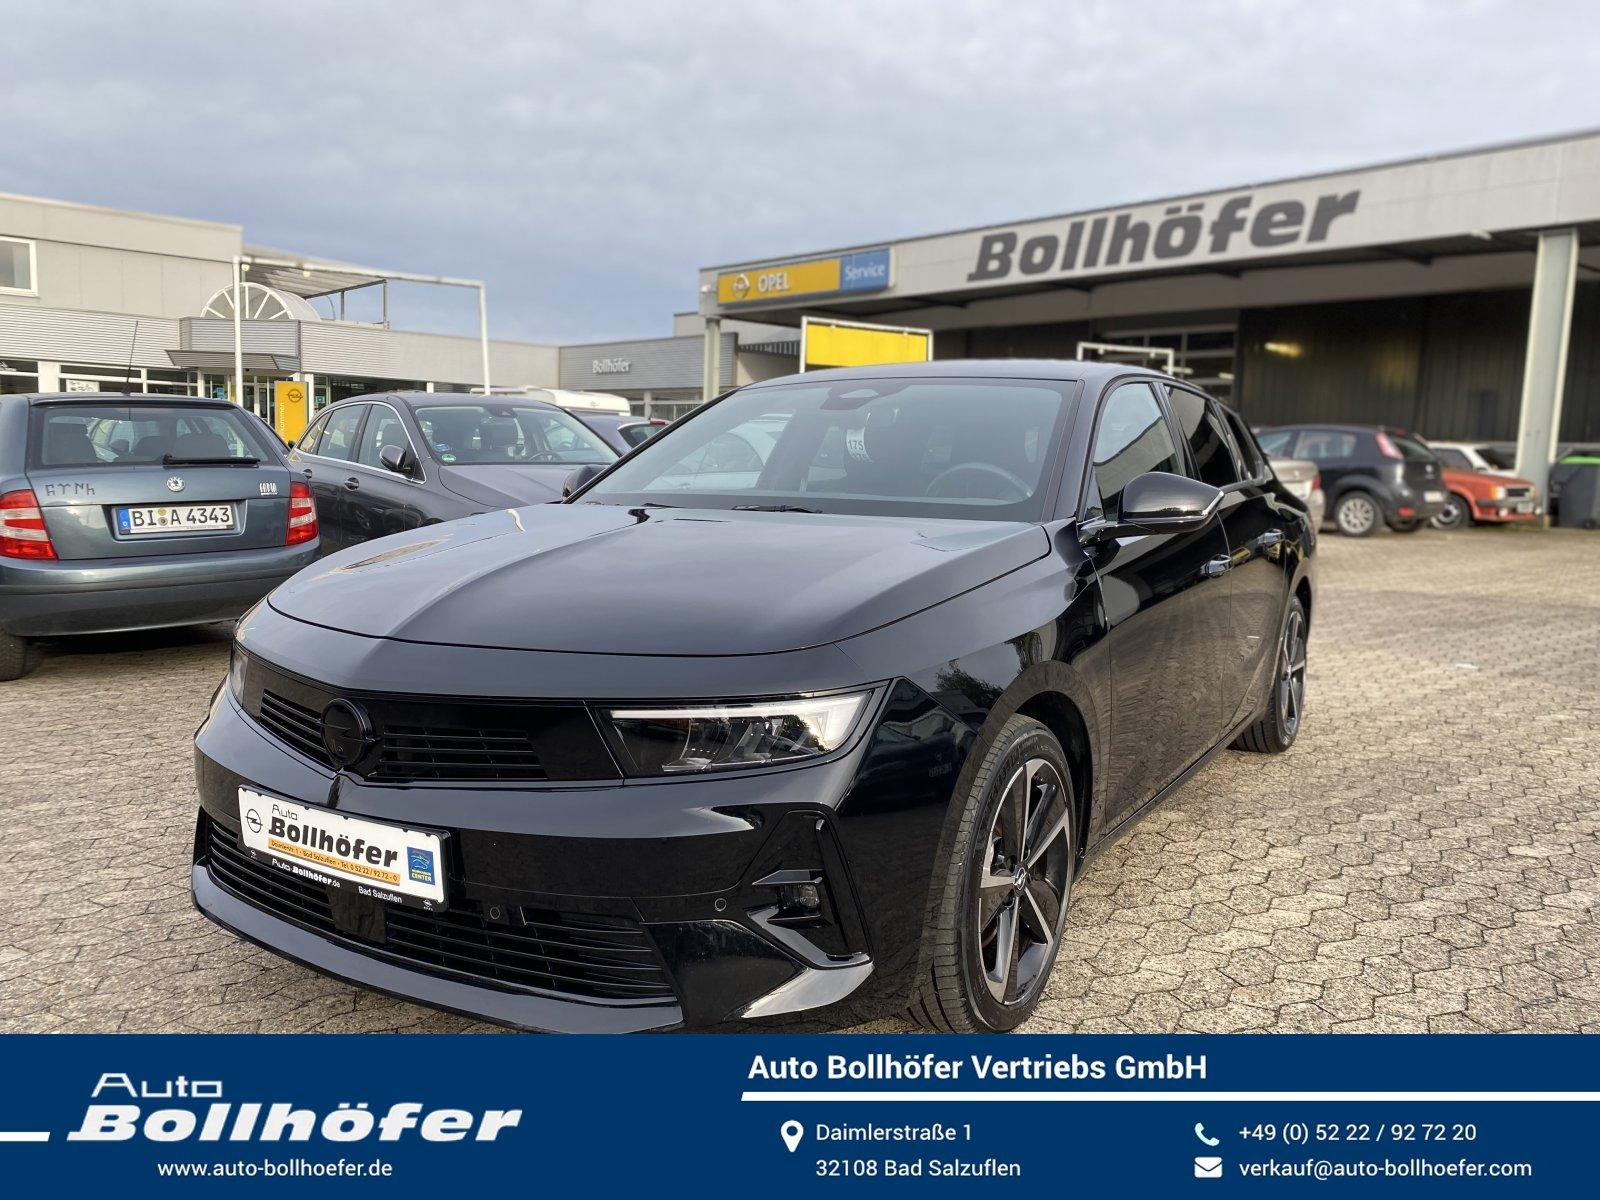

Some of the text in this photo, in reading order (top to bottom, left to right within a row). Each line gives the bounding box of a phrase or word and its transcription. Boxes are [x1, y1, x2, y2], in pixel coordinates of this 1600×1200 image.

[967, 190, 1361, 283] Bollhöfer
[757, 263, 886, 293] OPEL Service
[592, 357, 630, 373] Bollhöfer
[848, 440, 864, 451] 175
[132, 507, 230, 527] BI A 4343
[272, 804, 298, 821] Auto
[268, 816, 398, 867] Bollhöfer
[358, 886, 403, 904] Bad Salzuflen
